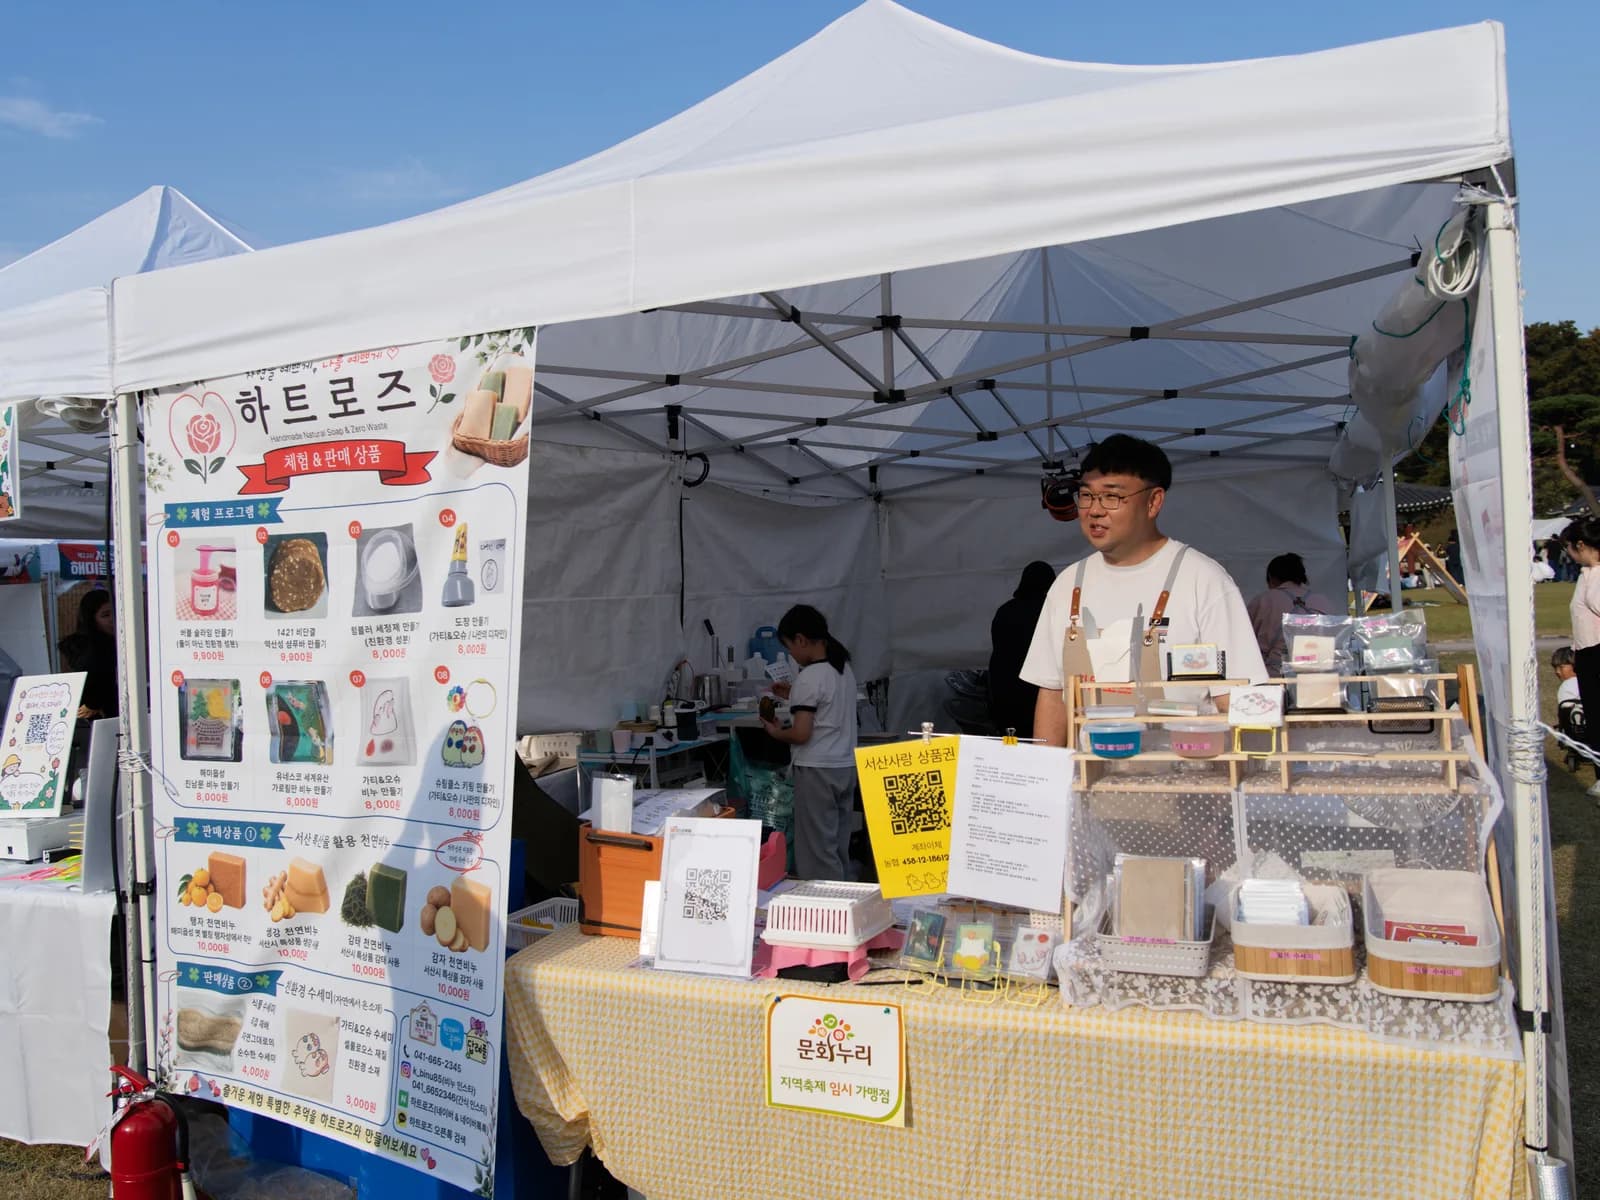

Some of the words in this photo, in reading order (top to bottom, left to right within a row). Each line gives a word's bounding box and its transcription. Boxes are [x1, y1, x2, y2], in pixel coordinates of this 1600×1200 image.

[236, 370, 416, 434] 하트로즈
[270, 432, 303, 443] Handmade
[303, 429, 326, 440] Natural
[326, 427, 344, 438] Soap
[345, 426, 350, 434] &
[351, 424, 366, 434] Zero
[366, 422, 388, 432] Waste
[284, 453, 308, 472] 체험
[312, 452, 322, 467] &
[324, 448, 351, 468] 판매
[354, 444, 382, 465] 상품
[191, 507, 210, 521] 체험
[214, 504, 254, 520] 프로그램
[277, 628, 294, 636] 1421
[193, 651, 225, 661] 9,900원
[281, 652, 313, 663] 9,900원
[864, 752, 913, 772] 서산사랑
[918, 746, 956, 766] 상품권
[206, 780, 218, 790] 비누
[220, 781, 240, 790] 만들기
[276, 772, 302, 782] 유네스코
[304, 774, 329, 784] 세계유산
[362, 775, 400, 786] 가티&오슈
[300, 786, 312, 795] 비누
[362, 788, 378, 797] 비누
[462, 781, 474, 792] 키링
[196, 792, 228, 803] 8,000원
[286, 798, 319, 809] 8,000원
[365, 800, 400, 811] 8,000원
[202, 825, 242, 840] 판매상품
[912, 840, 943, 852] 계좌이체
[206, 918, 236, 930] 천연비누
[198, 941, 229, 954] 10,000원
[363, 938, 392, 953] 천연비누
[352, 962, 385, 978] 10,000원
[432, 952, 446, 965] 감자
[449, 956, 478, 973] 천연비누
[203, 971, 235, 990] 판매상품
[438, 982, 470, 1001] 10,000원
[341, 1019, 372, 1037] 가티&오슈
[374, 1028, 394, 1044] 수세미
[797, 1034, 872, 1066] 문화누리
[242, 1064, 270, 1080] 4,000원
[348, 1058, 366, 1073] 친환경
[780, 1076, 826, 1094] 지역축제
[829, 1080, 852, 1097] 임시
[856, 1084, 890, 1105] 가맹점
[346, 1095, 376, 1114] 3,000원
[223, 1083, 246, 1102] 즐거운
[248, 1091, 264, 1108] 체험
[266, 1098, 292, 1116] 특별한
[294, 1104, 318, 1124] 추억을
[320, 1114, 362, 1138] 하트로즈와
[365, 1128, 418, 1158] 만들어보세요
[409, 1116, 433, 1134] 하트로즈
